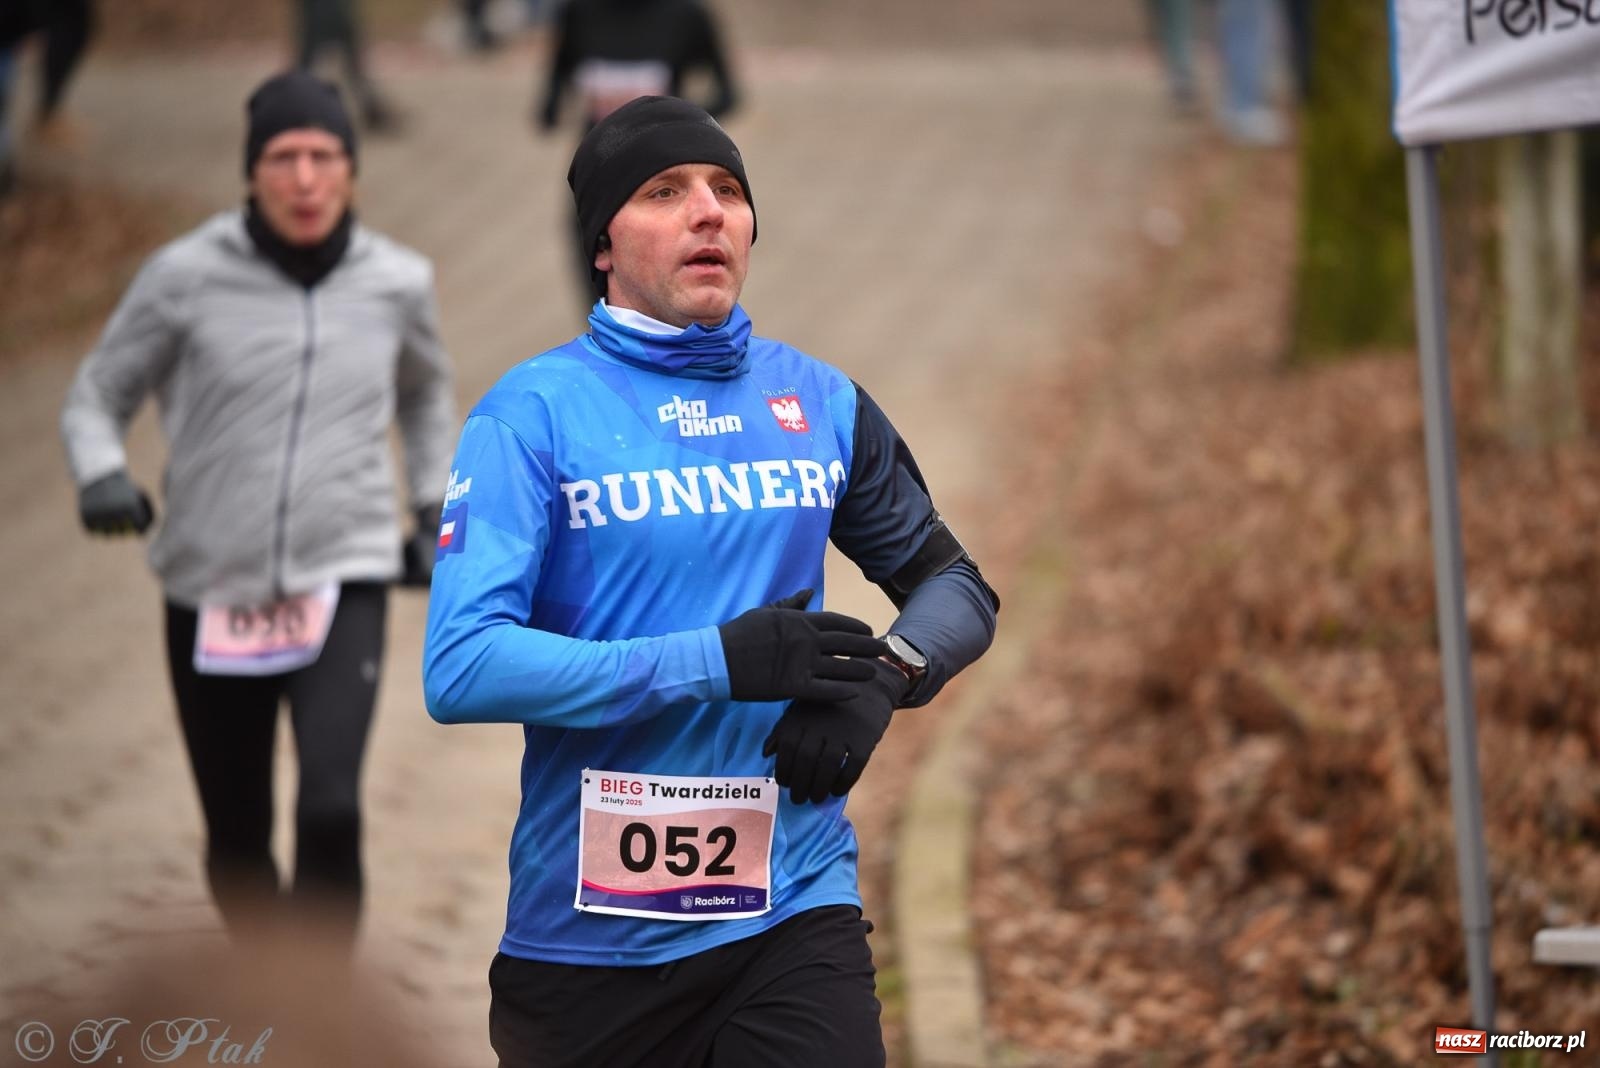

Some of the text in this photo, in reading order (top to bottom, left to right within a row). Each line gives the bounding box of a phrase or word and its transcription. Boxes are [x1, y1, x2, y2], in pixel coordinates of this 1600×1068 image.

[601, 778, 761, 799] BIEG Twardziela
[610, 797, 625, 806] luty
[619, 822, 737, 877] 052
[694, 895, 736, 906] Racibórz
